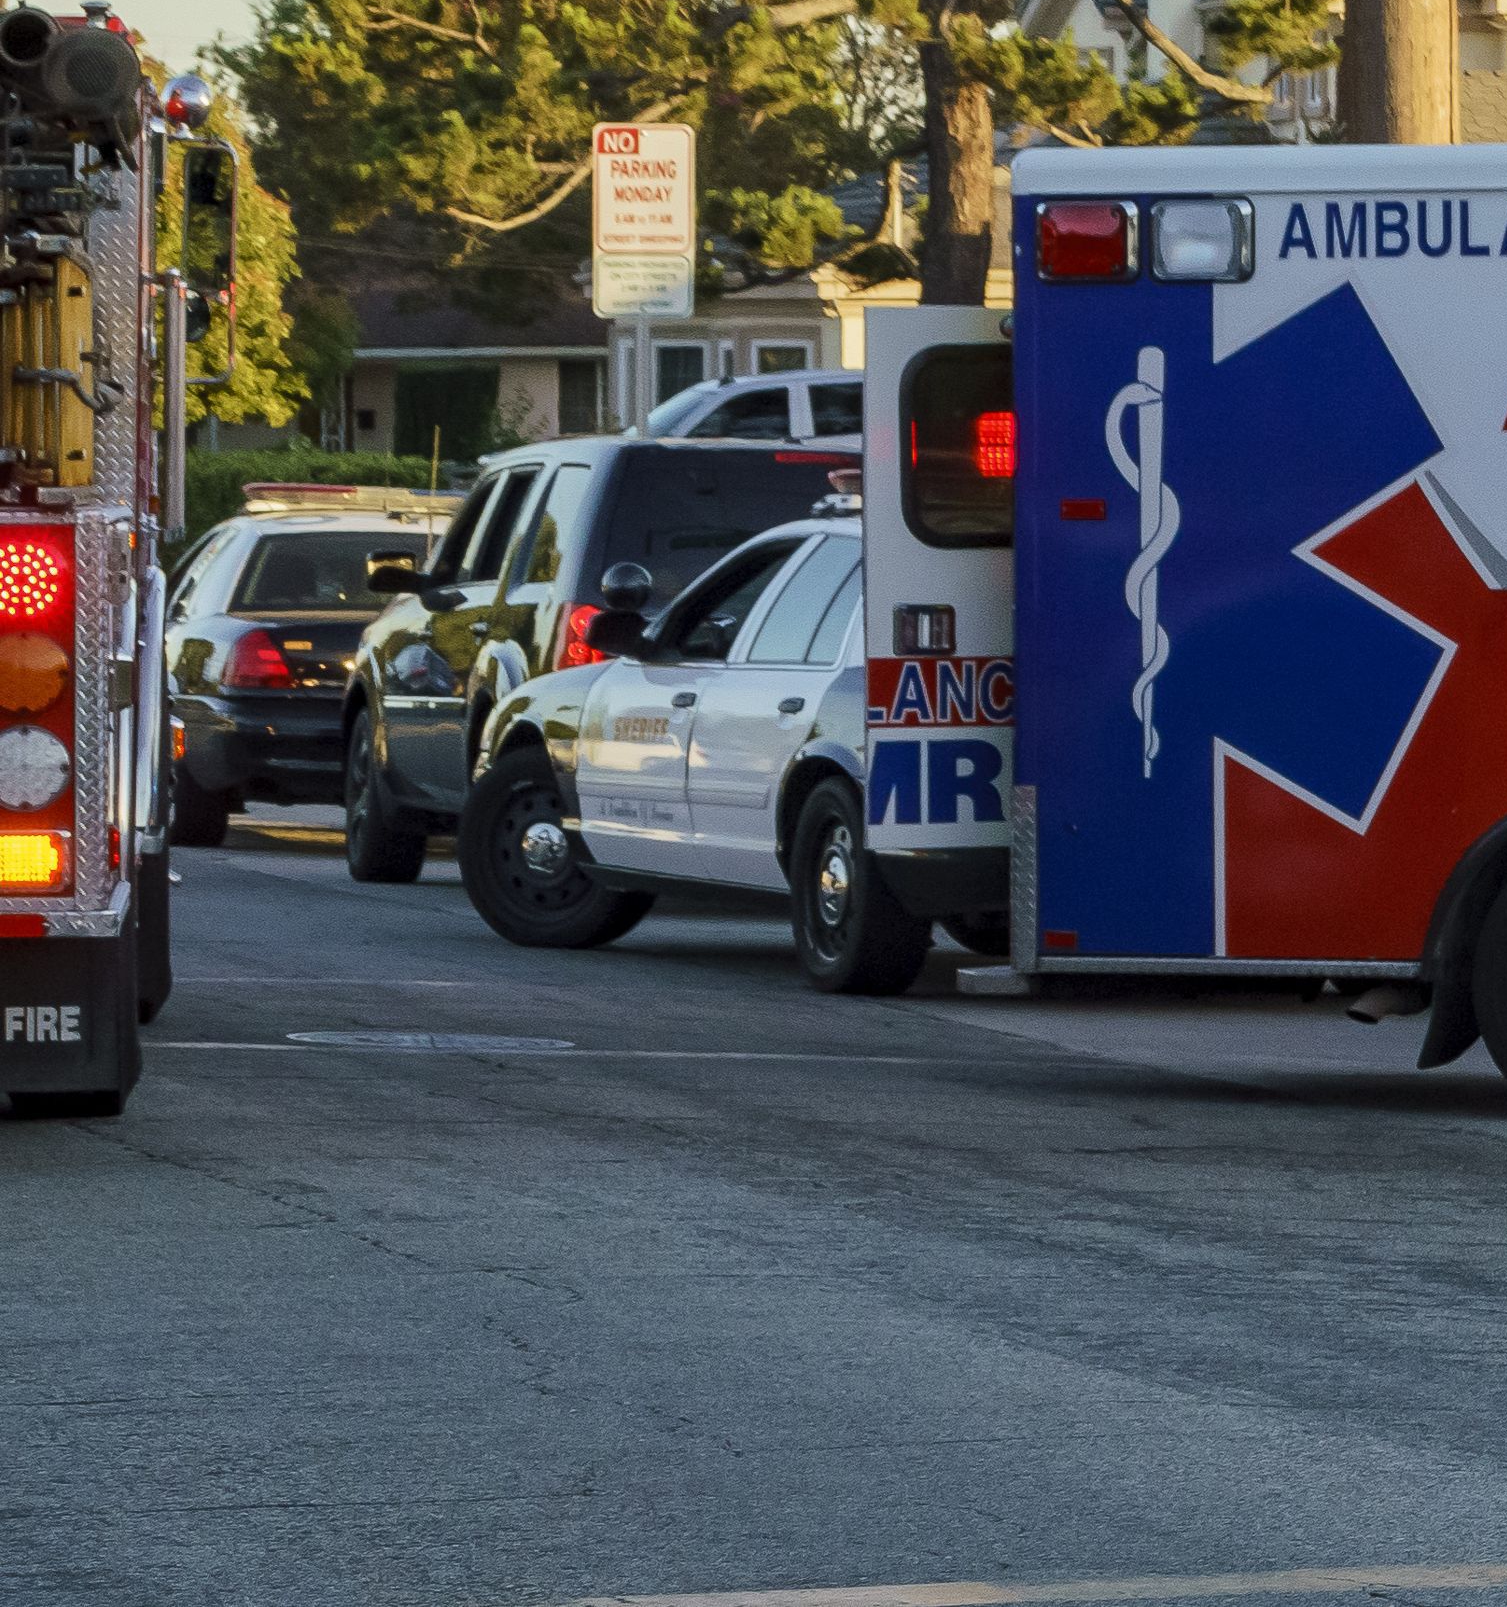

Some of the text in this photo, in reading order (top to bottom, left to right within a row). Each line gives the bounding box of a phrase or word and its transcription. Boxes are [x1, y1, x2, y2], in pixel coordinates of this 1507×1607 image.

[603, 131, 635, 153] NO
[610, 159, 677, 180] PARKING
[614, 185, 673, 202] MONDAY
[5, 1005, 82, 1042] FIRE
